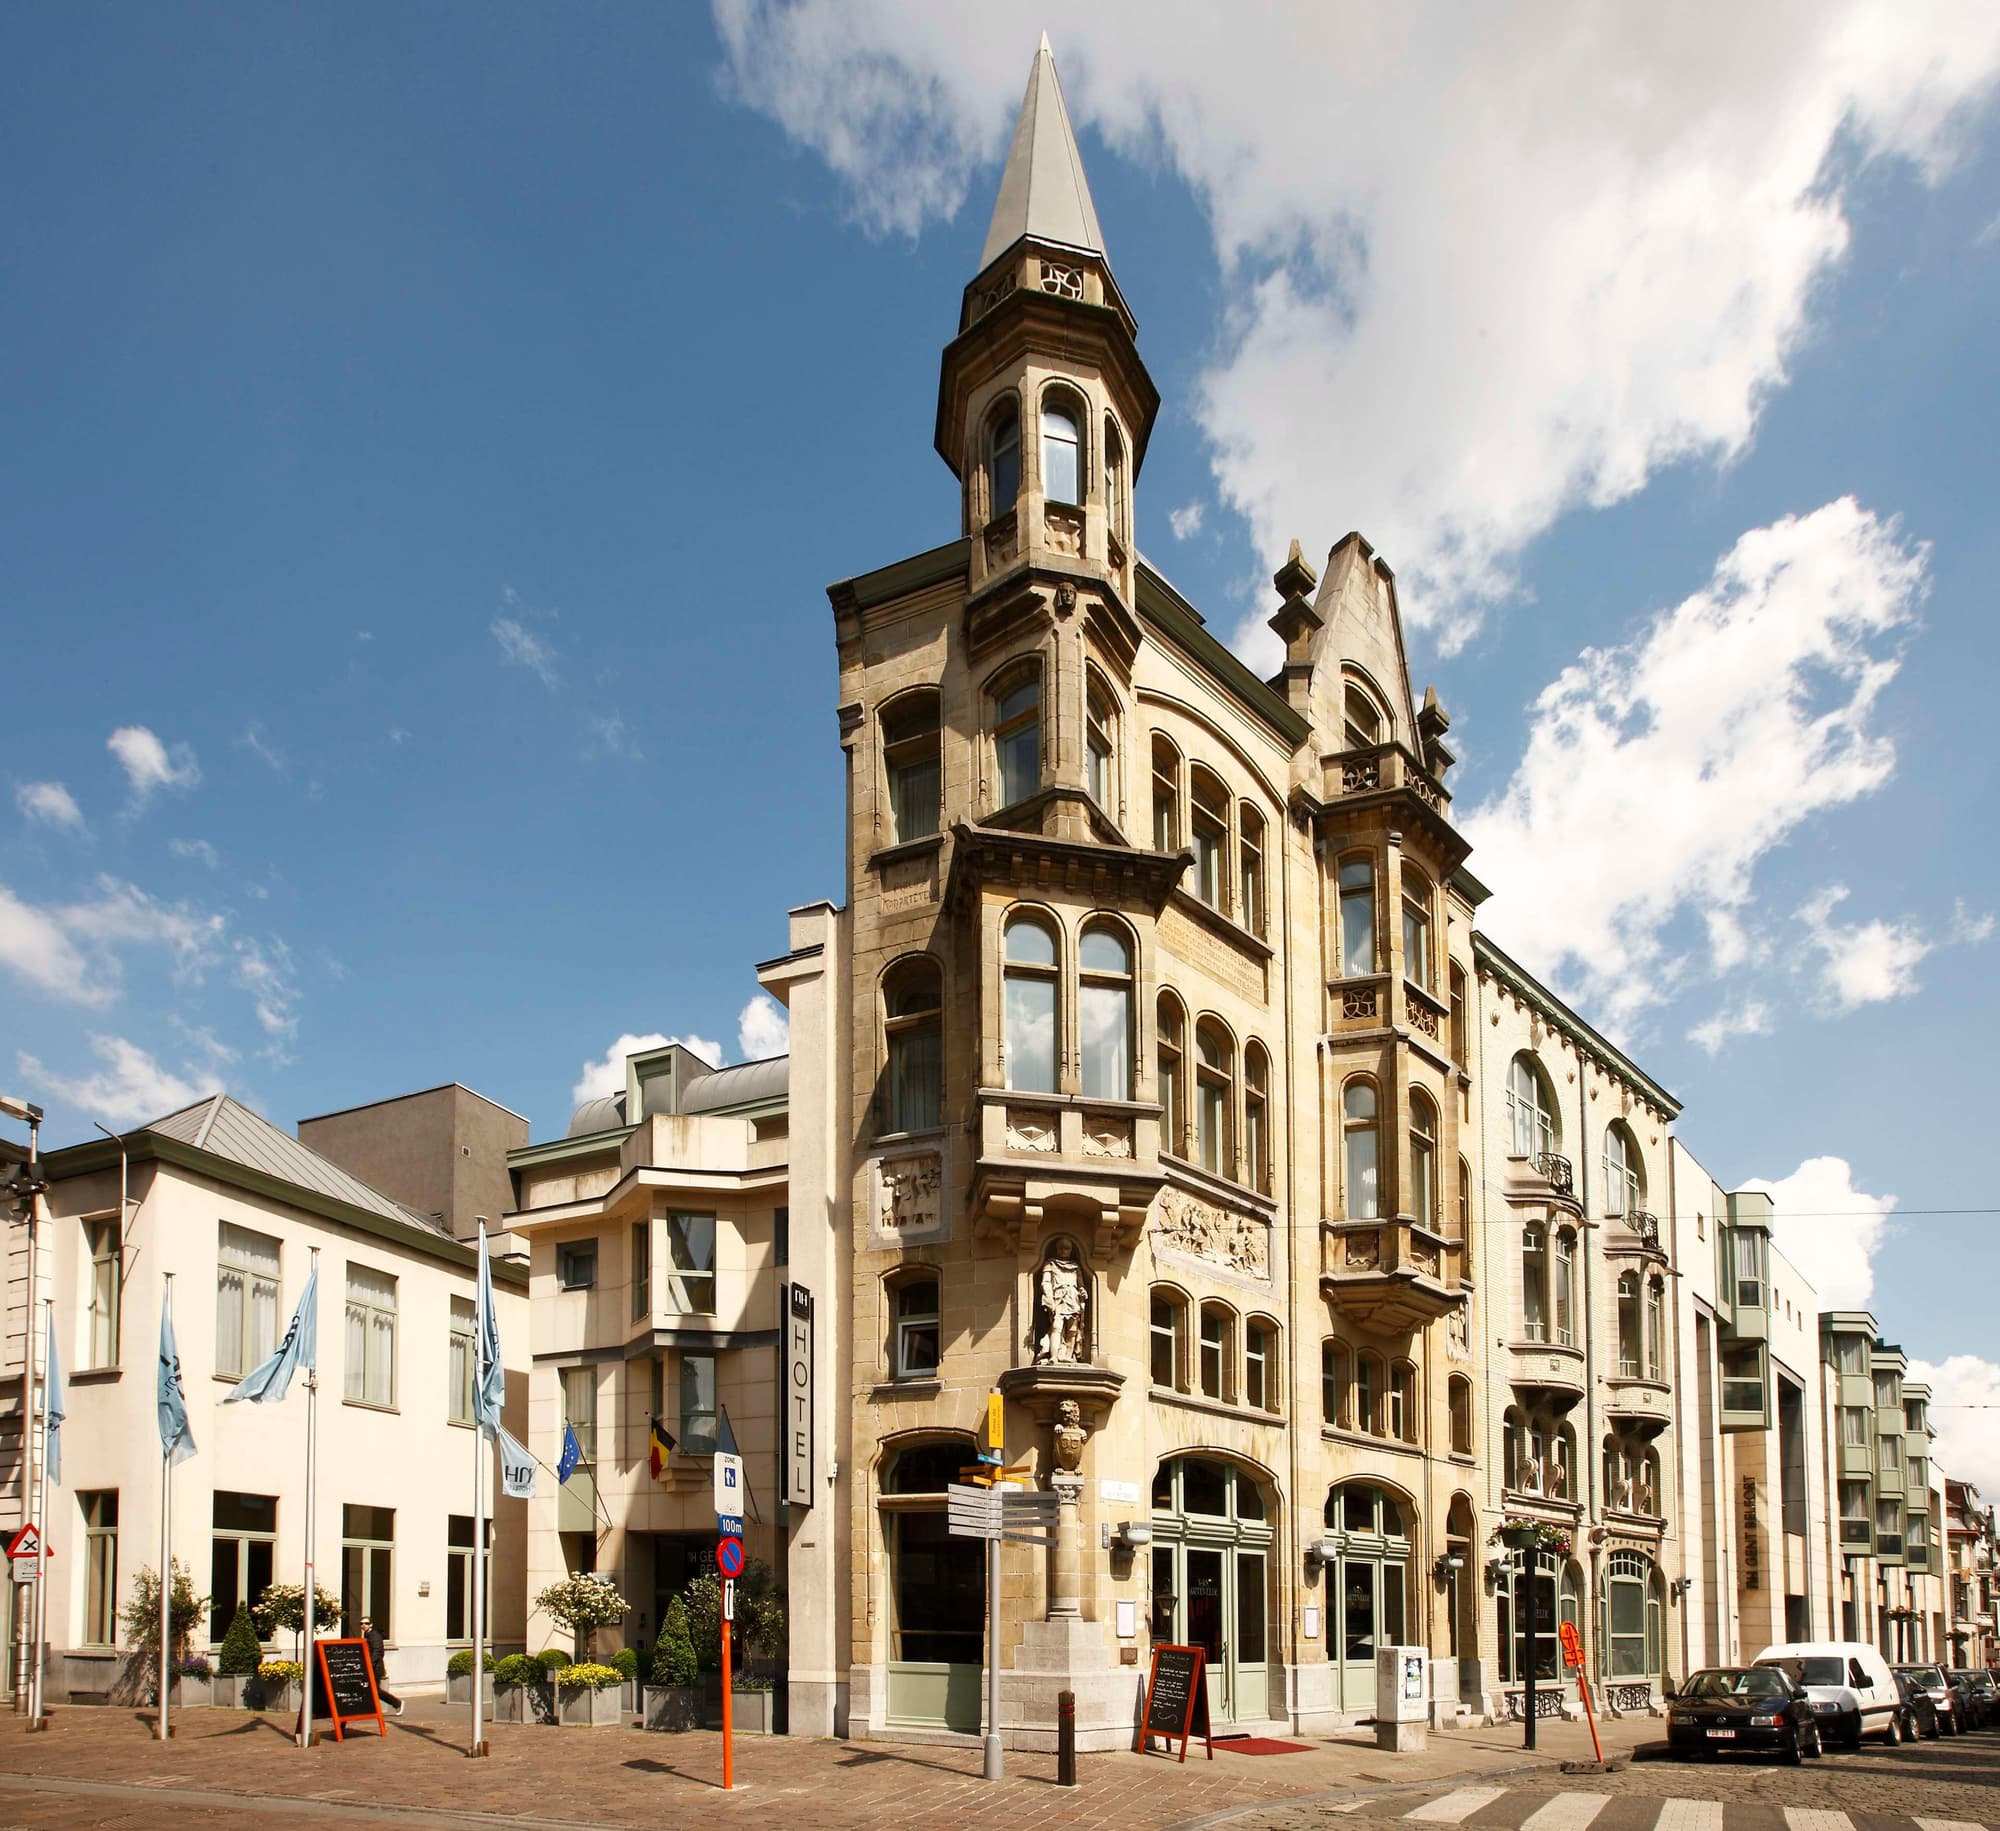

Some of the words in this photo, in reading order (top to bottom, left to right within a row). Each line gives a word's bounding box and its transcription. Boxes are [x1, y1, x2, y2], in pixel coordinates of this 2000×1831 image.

[793, 1324, 808, 1493] HOTEL
[724, 1456, 736, 1464] ZONE
[1743, 1475, 1757, 1529] BELFORT
[722, 1519, 743, 1534] 100m
[1744, 1532, 1758, 1567] GENT
